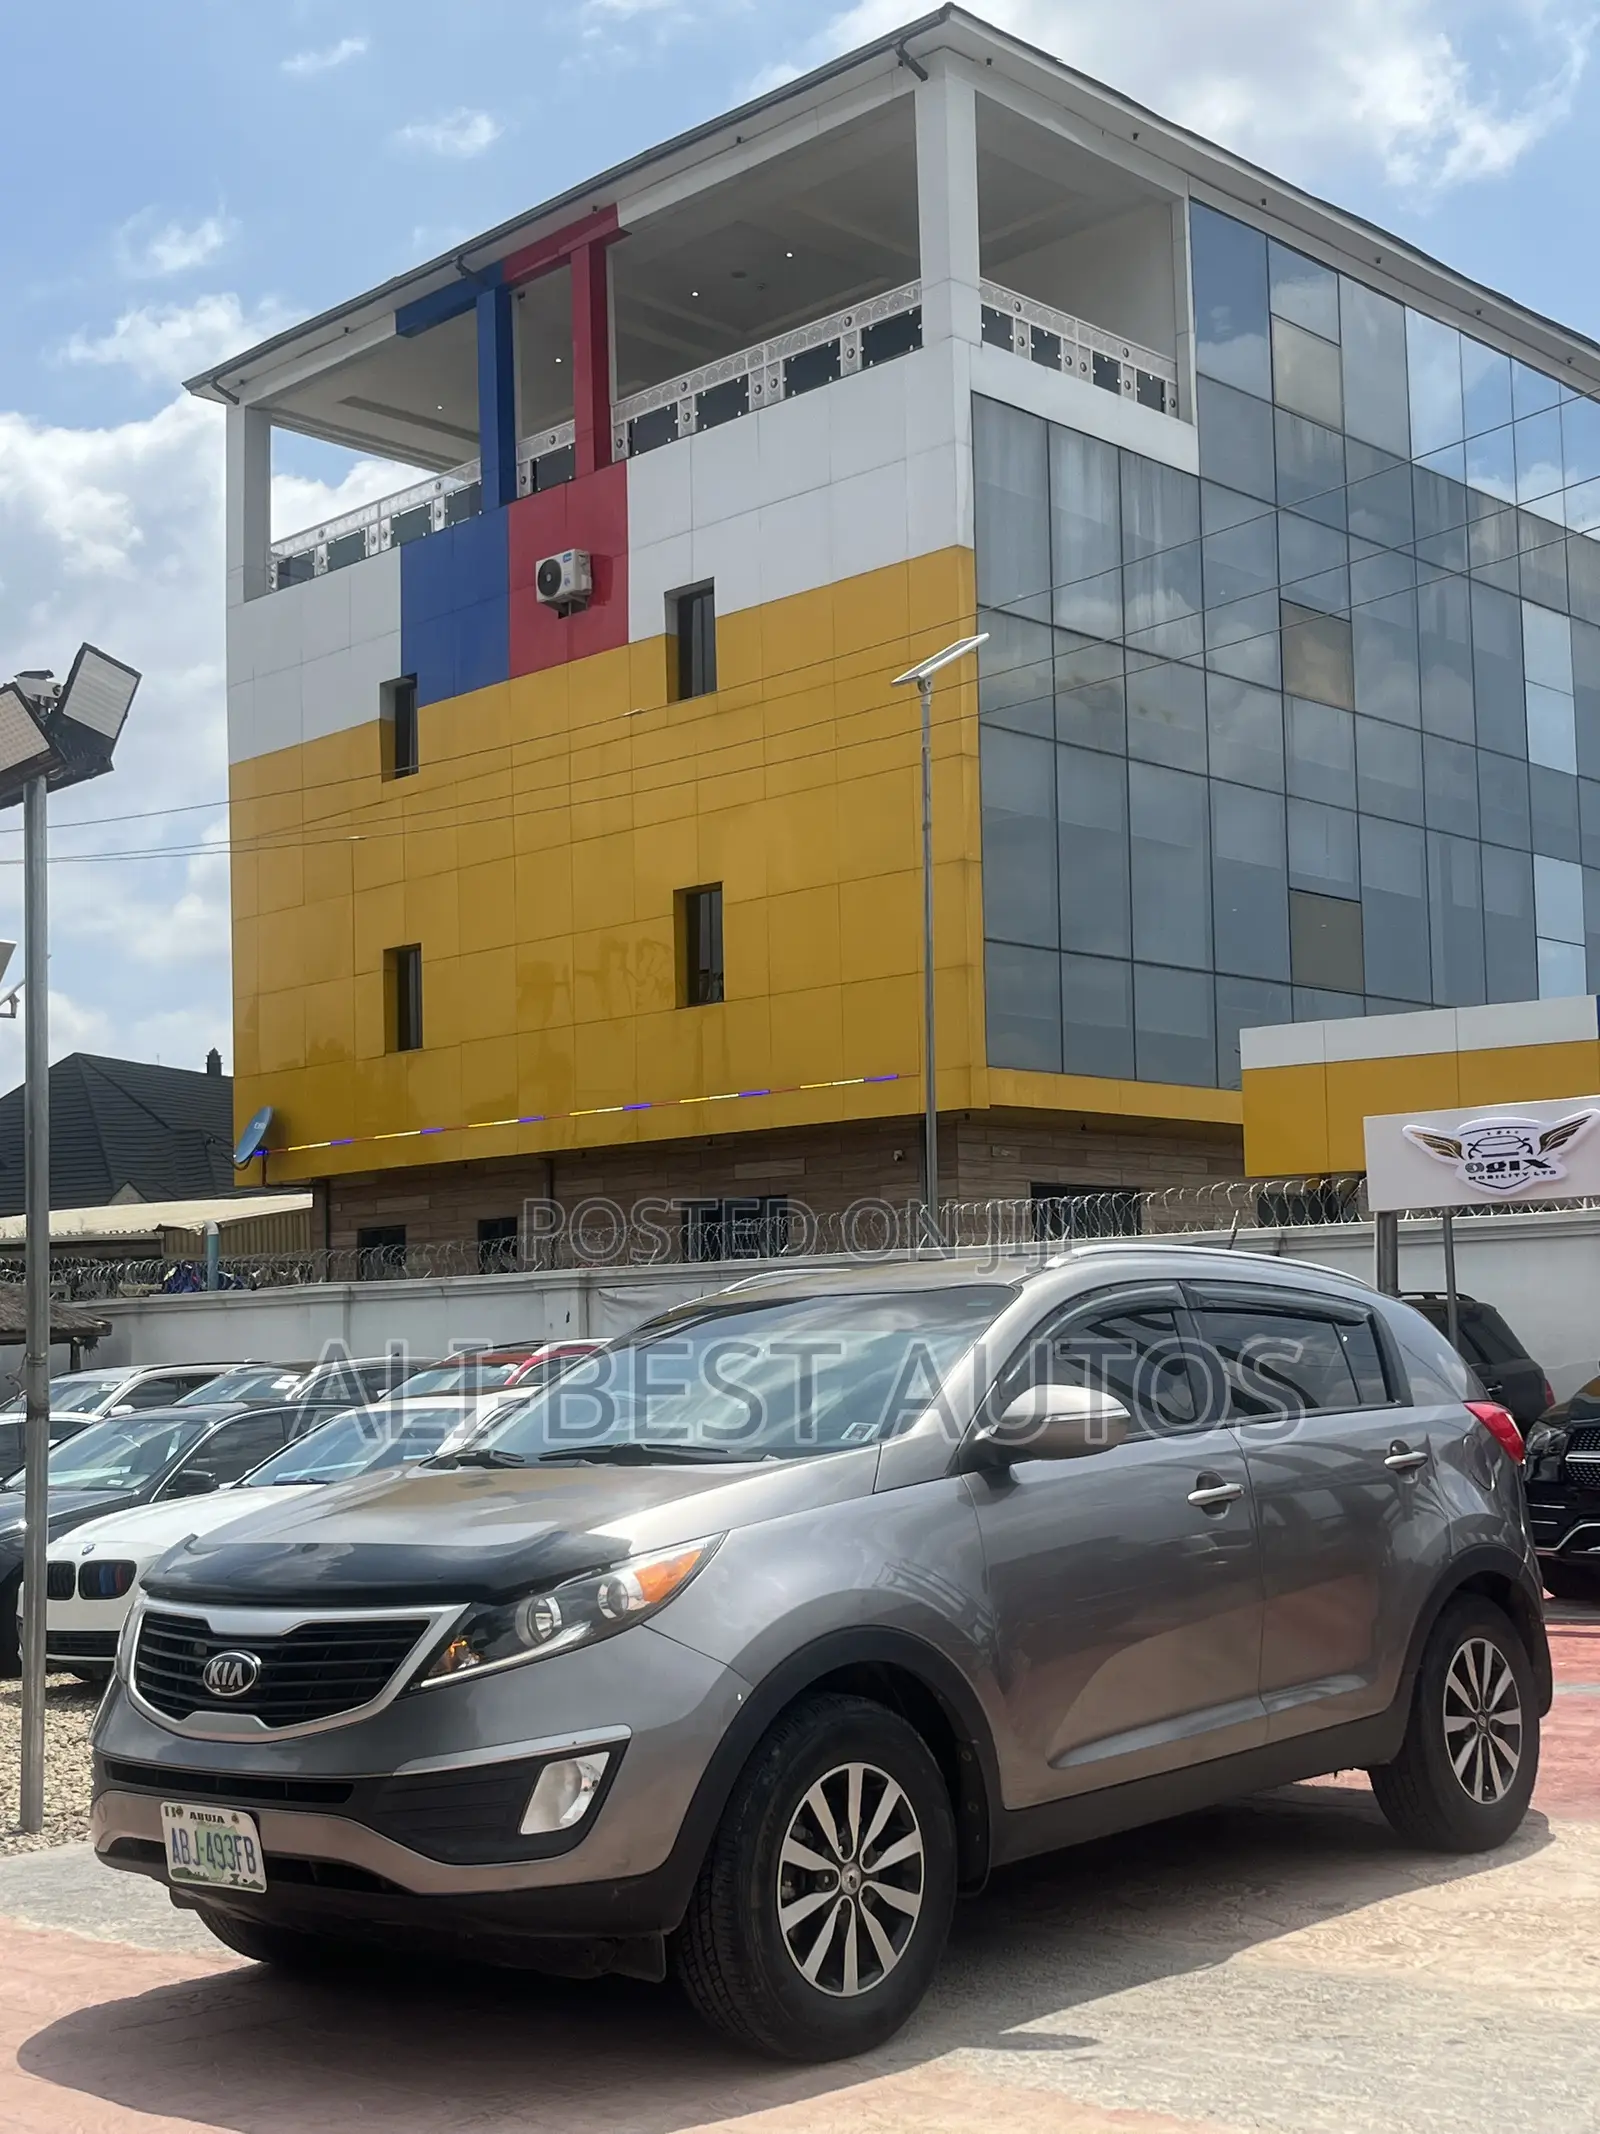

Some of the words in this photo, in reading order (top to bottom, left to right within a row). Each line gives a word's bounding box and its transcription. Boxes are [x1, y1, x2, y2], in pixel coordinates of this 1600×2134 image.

[1468, 1172, 1529, 1180] MOBILITY
[208, 1661, 244, 1686] KIA
[189, 1811, 225, 1824] ABUJA
[171, 1827, 257, 1875] ABJ-493FB
